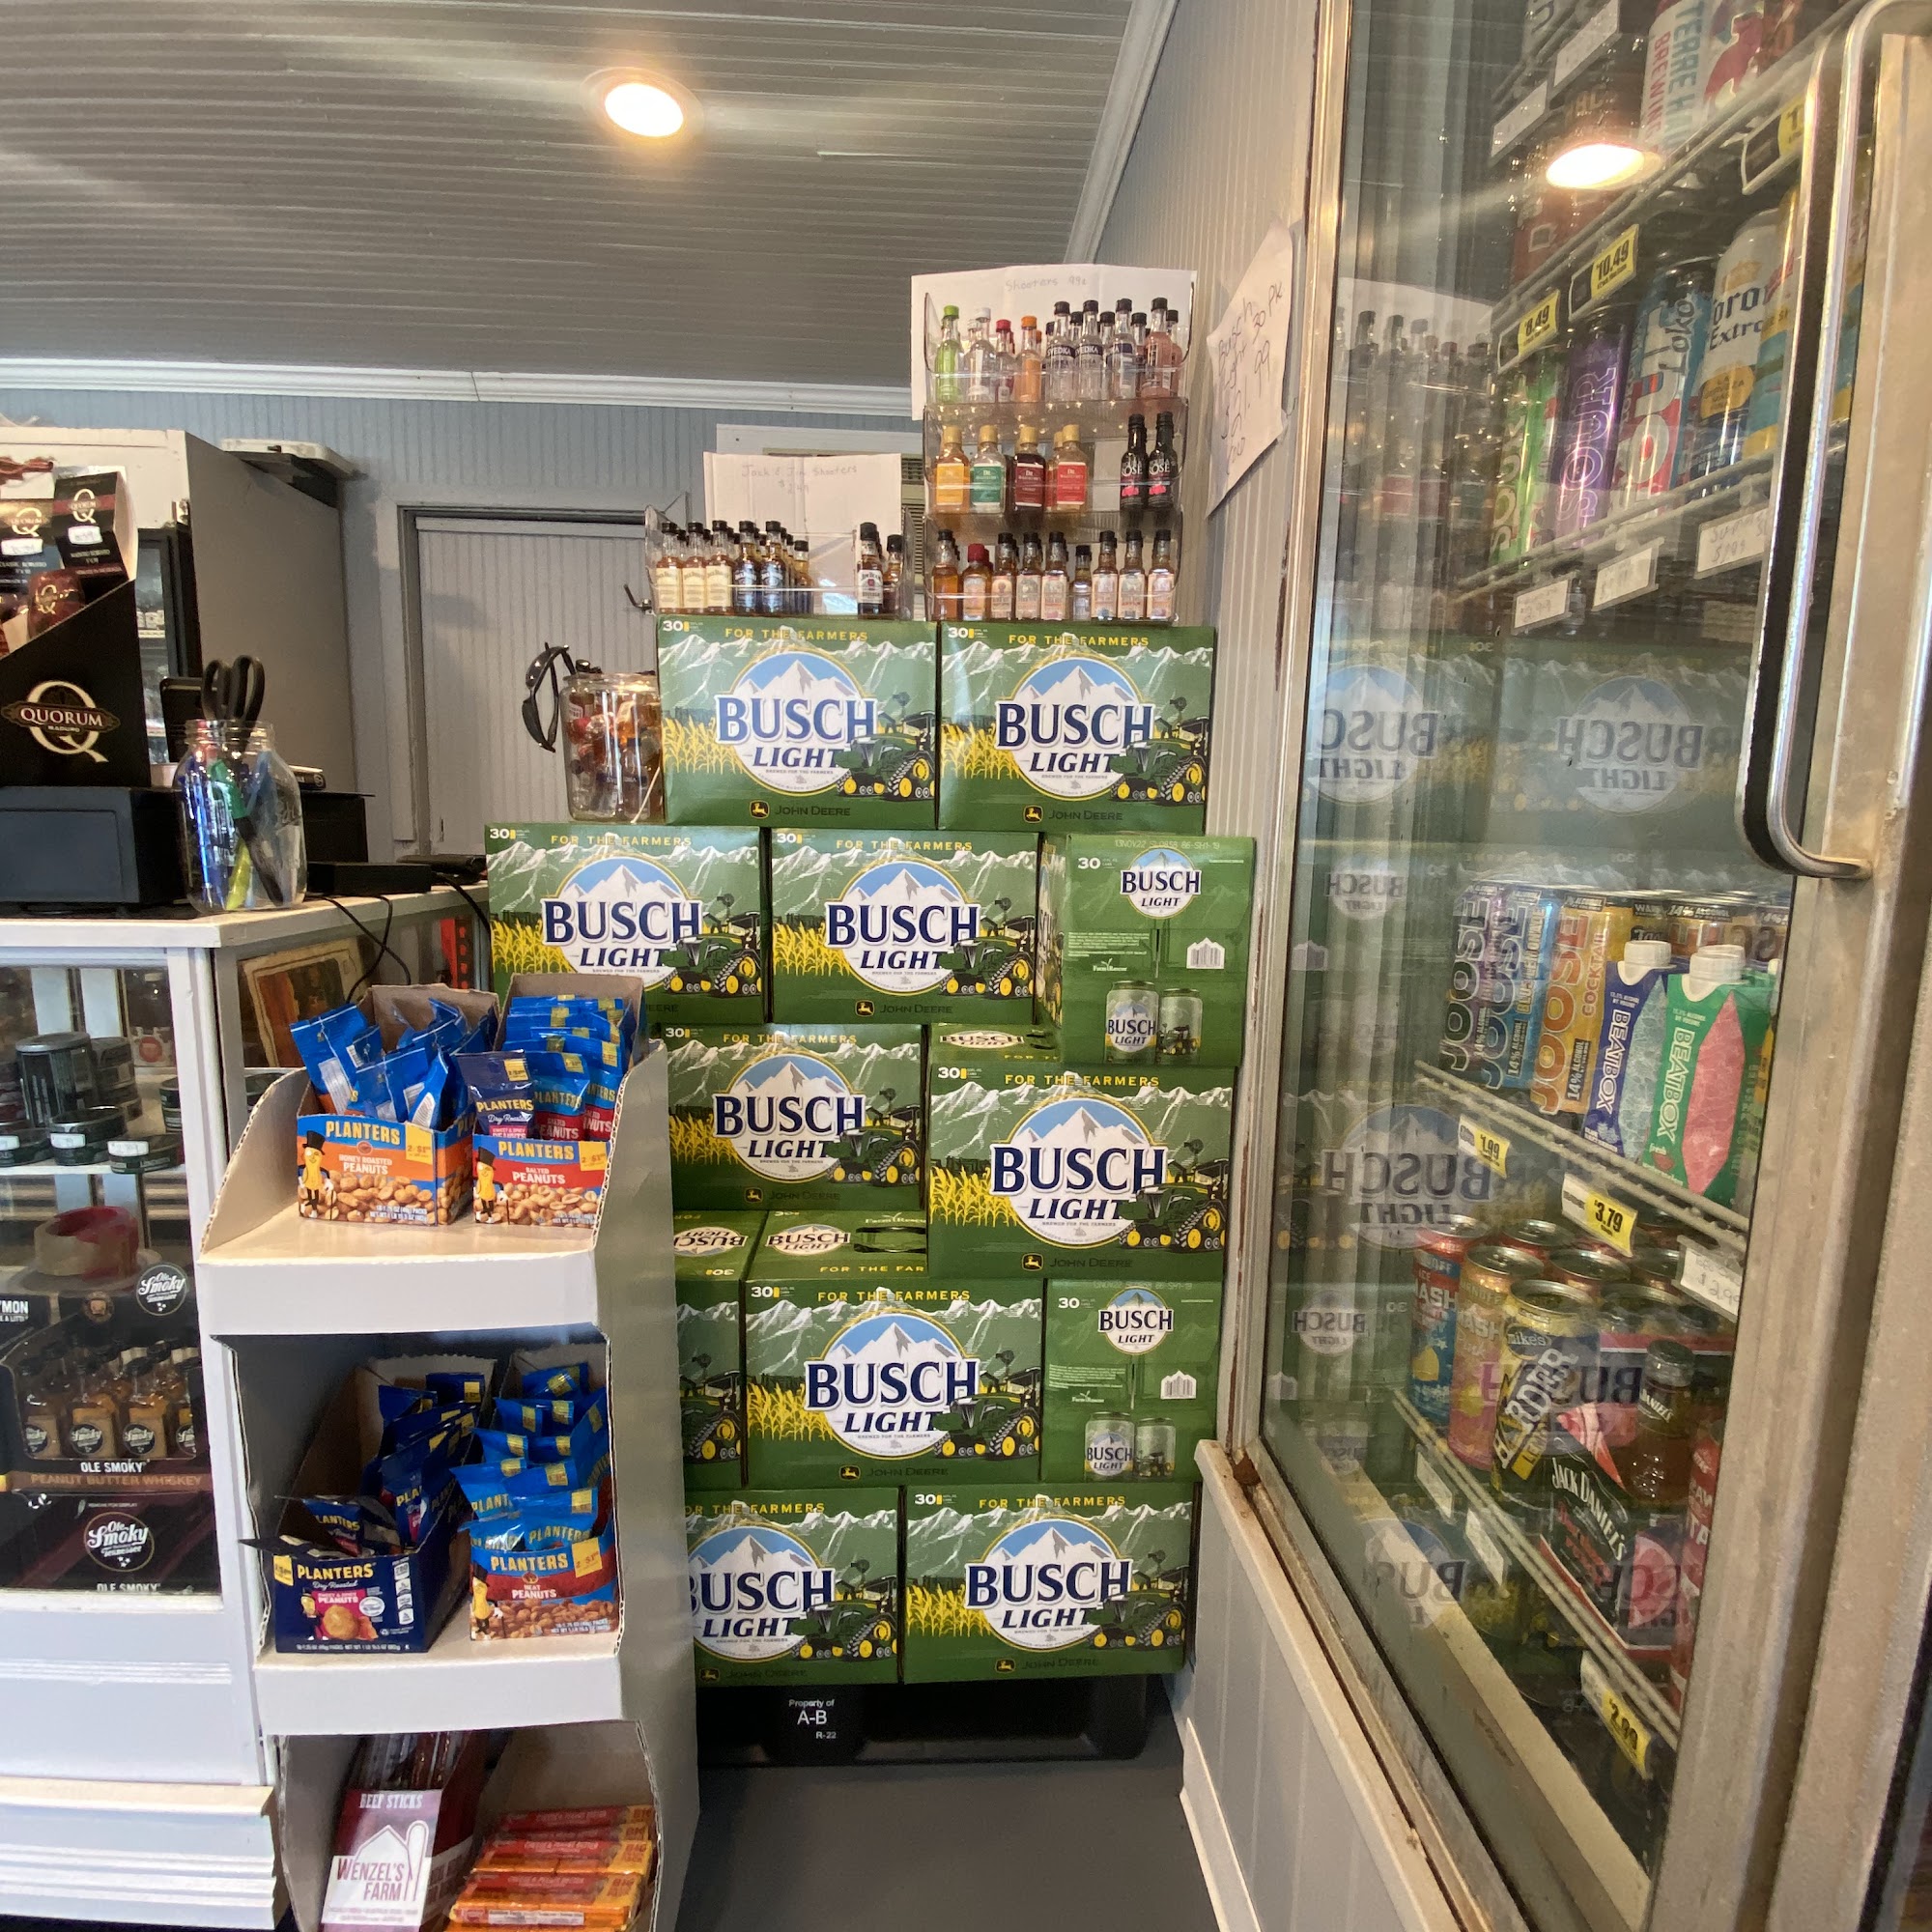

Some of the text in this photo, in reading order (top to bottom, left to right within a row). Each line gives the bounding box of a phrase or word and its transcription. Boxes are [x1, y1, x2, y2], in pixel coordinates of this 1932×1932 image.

[1005, 278, 1059, 292] Shooters
[742, 464, 772, 478] Jack
[813, 465, 857, 476] Shooters
[663, 621, 683, 631] 30
[724, 629, 868, 641] FOR THE FARMERS
[948, 628, 968, 639] 30
[1009, 635, 1149, 646] FOR THE FARMERS
[20, 707, 102, 726] QUORUM
[718, 696, 877, 744] BUSCH
[997, 703, 1152, 749] BUSCH
[753, 747, 845, 767] LIGHT
[1030, 753, 1122, 773] LIGHT
[775, 805, 850, 816] JOHN DEERE
[1048, 810, 1122, 820] JOHN DEERE
[490, 829, 509, 838] 30
[777, 833, 796, 843] 30
[551, 836, 692, 846] FOR THE FARMERS
[836, 840, 973, 851] FOR THE FARMERS
[1078, 858, 1100, 869] 30
[1122, 871, 1201, 894] BUSCH
[1141, 897, 1180, 907] LIGHT
[544, 900, 699, 944] BUSCH
[828, 904, 979, 947] BUSCH
[580, 948, 672, 967] LIGHT
[860, 951, 949, 969] LIGHT
[1581, 932, 1605, 1018] COCKTAIL
[1530, 914, 1591, 1115] JOOSE
[666, 1028, 685, 1037] 30
[1108, 1020, 1155, 1036] BUSCH
[724, 1034, 857, 1044] FOR THE FARMERS
[1596, 1009, 1631, 1115] BEATBOX
[938, 1066, 960, 1079] 30
[1567, 1041, 1584, 1101] 14% ALCOHOL
[1005, 1074, 1159, 1087] FOR THE FARMERS
[1657, 1027, 1695, 1144] BEATBOX
[476, 1099, 533, 1113] PLANTERS
[715, 1095, 864, 1136] BUSCH
[326, 1121, 400, 1145] PLANTERS
[498, 1141, 574, 1160] PLANTERS
[748, 1140, 835, 1157] LIGHT
[339, 1154, 392, 1166] HONEY ROASTED
[343, 1162, 388, 1175] PEANUTS
[992, 1147, 1165, 1194] BUSCH
[512, 1171, 565, 1184] PEANUTS
[1029, 1198, 1133, 1220] LIGHT
[1594, 1200, 1623, 1232] $3.79
[768, 1233, 849, 1246] BUSCH
[138, 1276, 186, 1295] Smoky
[751, 1287, 773, 1297] 30
[818, 1290, 970, 1302] FOR THE FARMERS
[1059, 1297, 1080, 1309] 30
[1099, 1310, 1173, 1331] BUSCH
[1118, 1335, 1154, 1344] LIGHT
[1508, 1332, 1546, 1347] mike's
[807, 1360, 979, 1409] BUSCH
[843, 1411, 944, 1433] LIGHT
[1087, 1447, 1133, 1462] BUSCH
[81, 1462, 147, 1473] OLE SMOKY
[31, 1474, 202, 1486] PEANUT BUTTER WHISKEY
[914, 1493, 936, 1505] 30
[979, 1496, 1126, 1509] FOR THE FARMERS
[685, 1502, 825, 1515] OR THE FARMERS
[1551, 1457, 1578, 1493] JACK
[1580, 1471, 1626, 1561] DANIEL'S
[108, 1520, 129, 1532] Ole
[316, 1515, 360, 1531] LANTERS
[87, 1524, 149, 1548] Smoky
[101, 1546, 142, 1558] Tennessee
[491, 1553, 568, 1571] PLANTERS
[298, 1563, 374, 1579] PLANTERS
[313, 1581, 327, 1590] Dry
[968, 1561, 1130, 1607] BUSCH
[512, 1589, 556, 1599] PEANUTS
[1002, 1607, 1098, 1629] LIGHT
[702, 1617, 801, 1637] LIGHT
[789, 1699, 824, 1708] Property
[797, 1710, 827, 1724] A-B
[359, 1794, 423, 1808] BEEF STICKS
[337, 1859, 404, 1881] WENZEL'S
[363, 1884, 402, 1901] FARM
